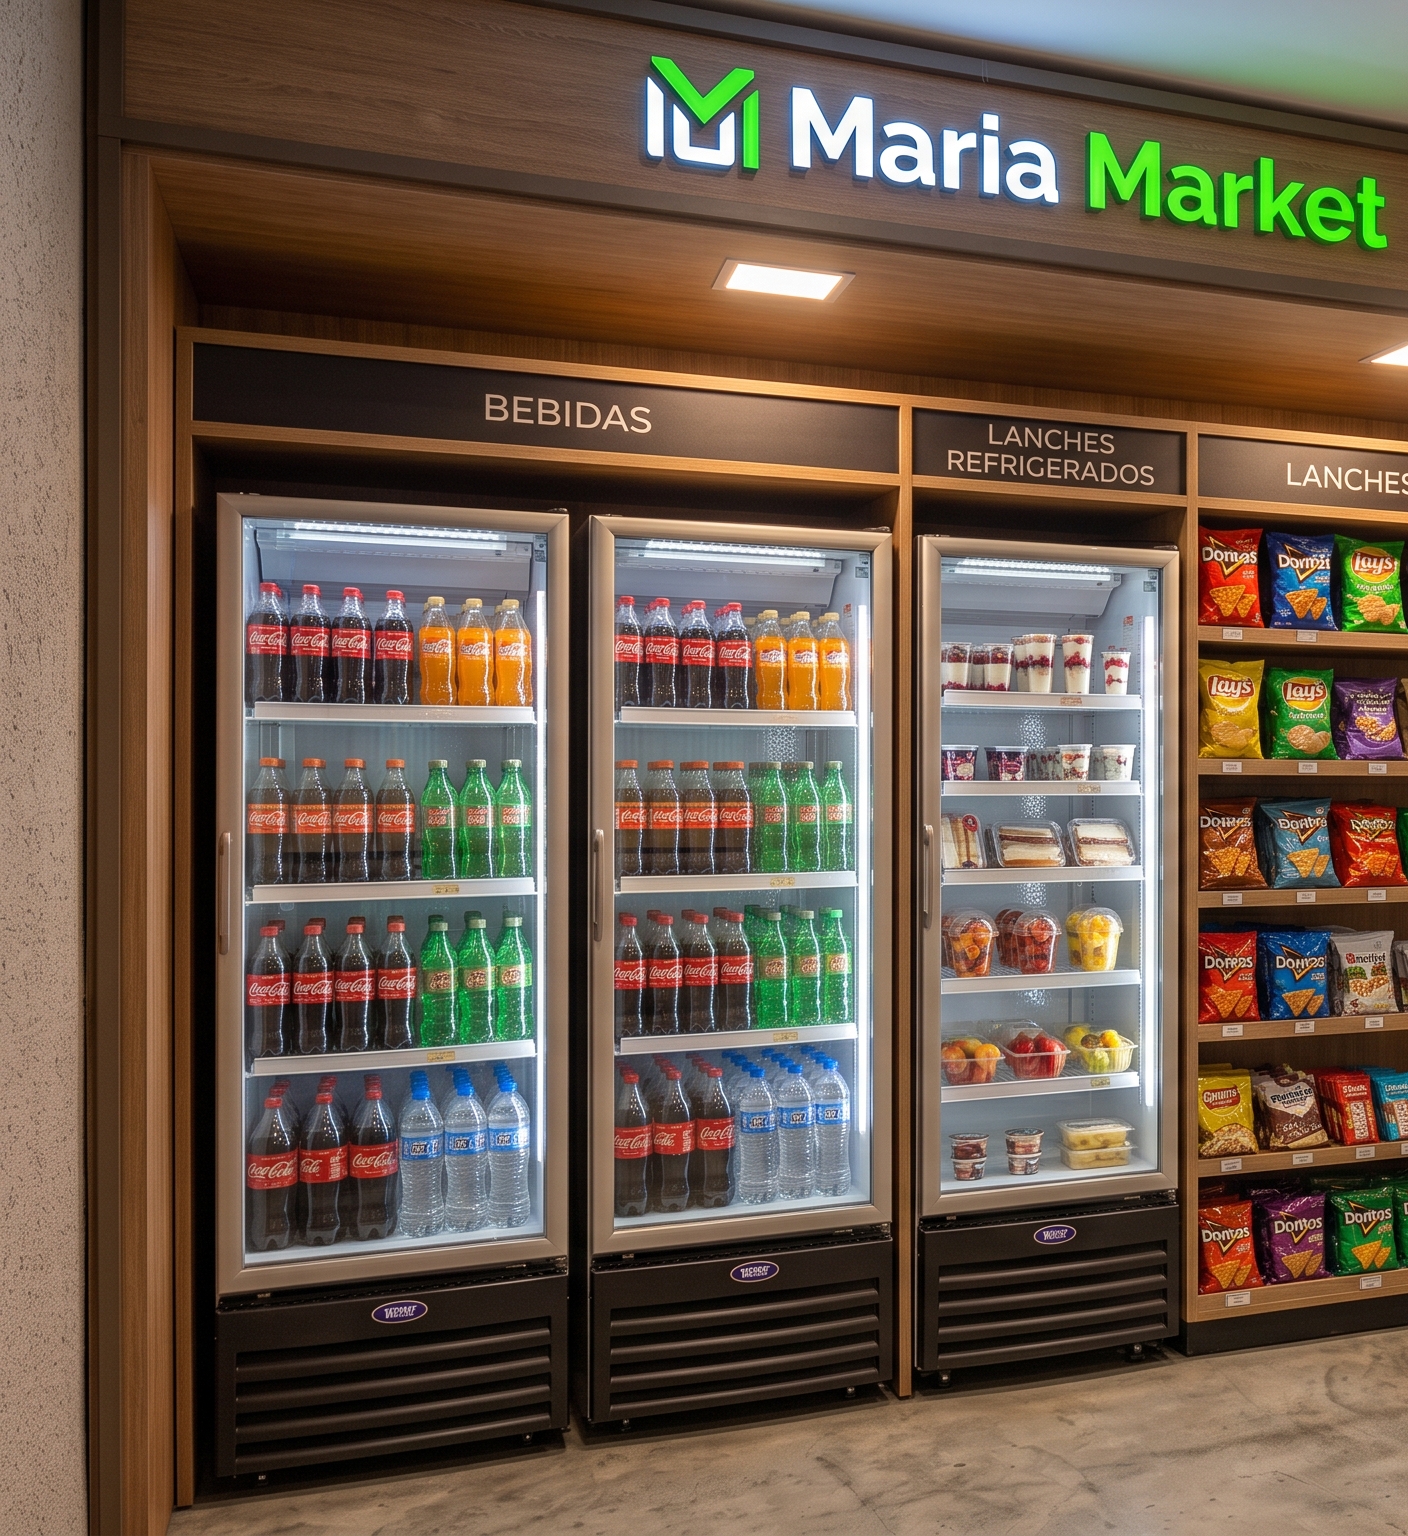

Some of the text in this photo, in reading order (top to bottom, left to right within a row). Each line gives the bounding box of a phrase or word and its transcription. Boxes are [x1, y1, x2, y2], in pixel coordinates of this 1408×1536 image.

[790, 86, 1389, 250] Maria Market
[484, 393, 653, 435] BEBIDAS
[986, 422, 1115, 455] LANCHES
[946, 449, 1156, 487] REFRIGERADOS
